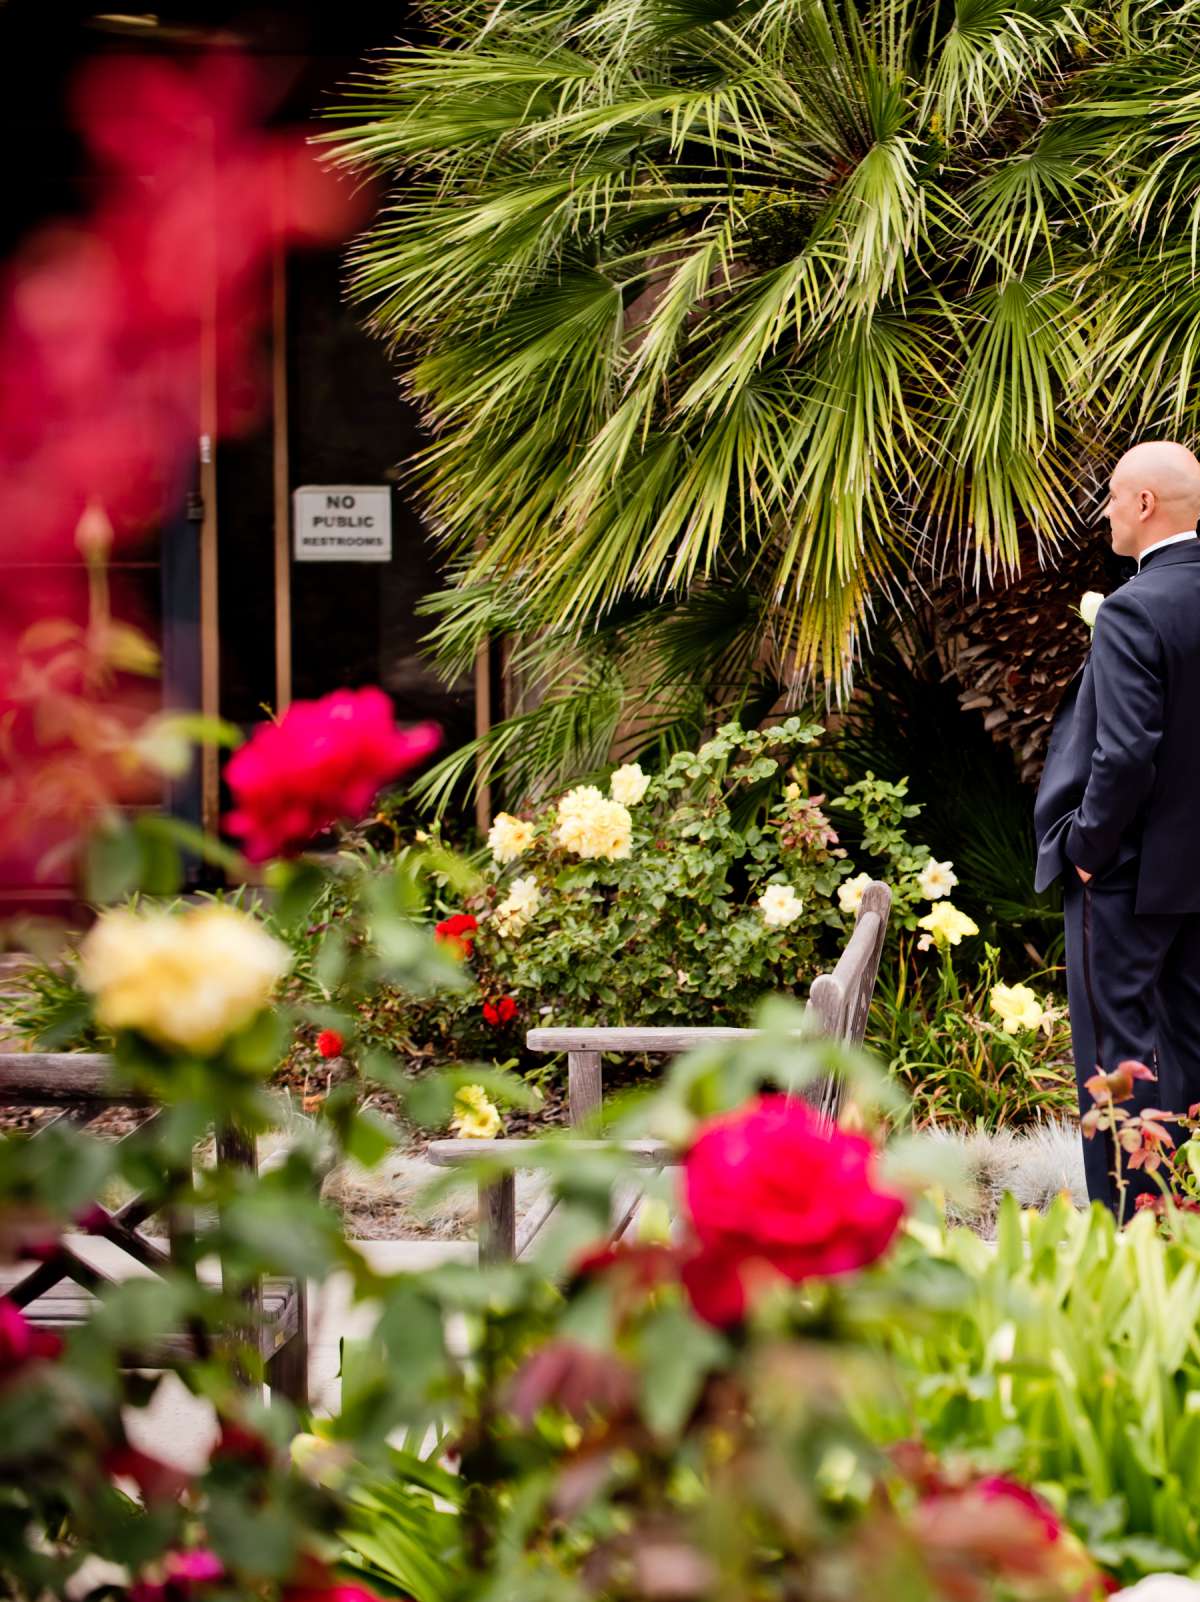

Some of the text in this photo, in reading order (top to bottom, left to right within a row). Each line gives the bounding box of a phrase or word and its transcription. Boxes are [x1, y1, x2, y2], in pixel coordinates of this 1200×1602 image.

[326, 495, 356, 509] NO
[312, 516, 375, 528] PUBLIC
[302, 537, 384, 546] RESTROOMS
